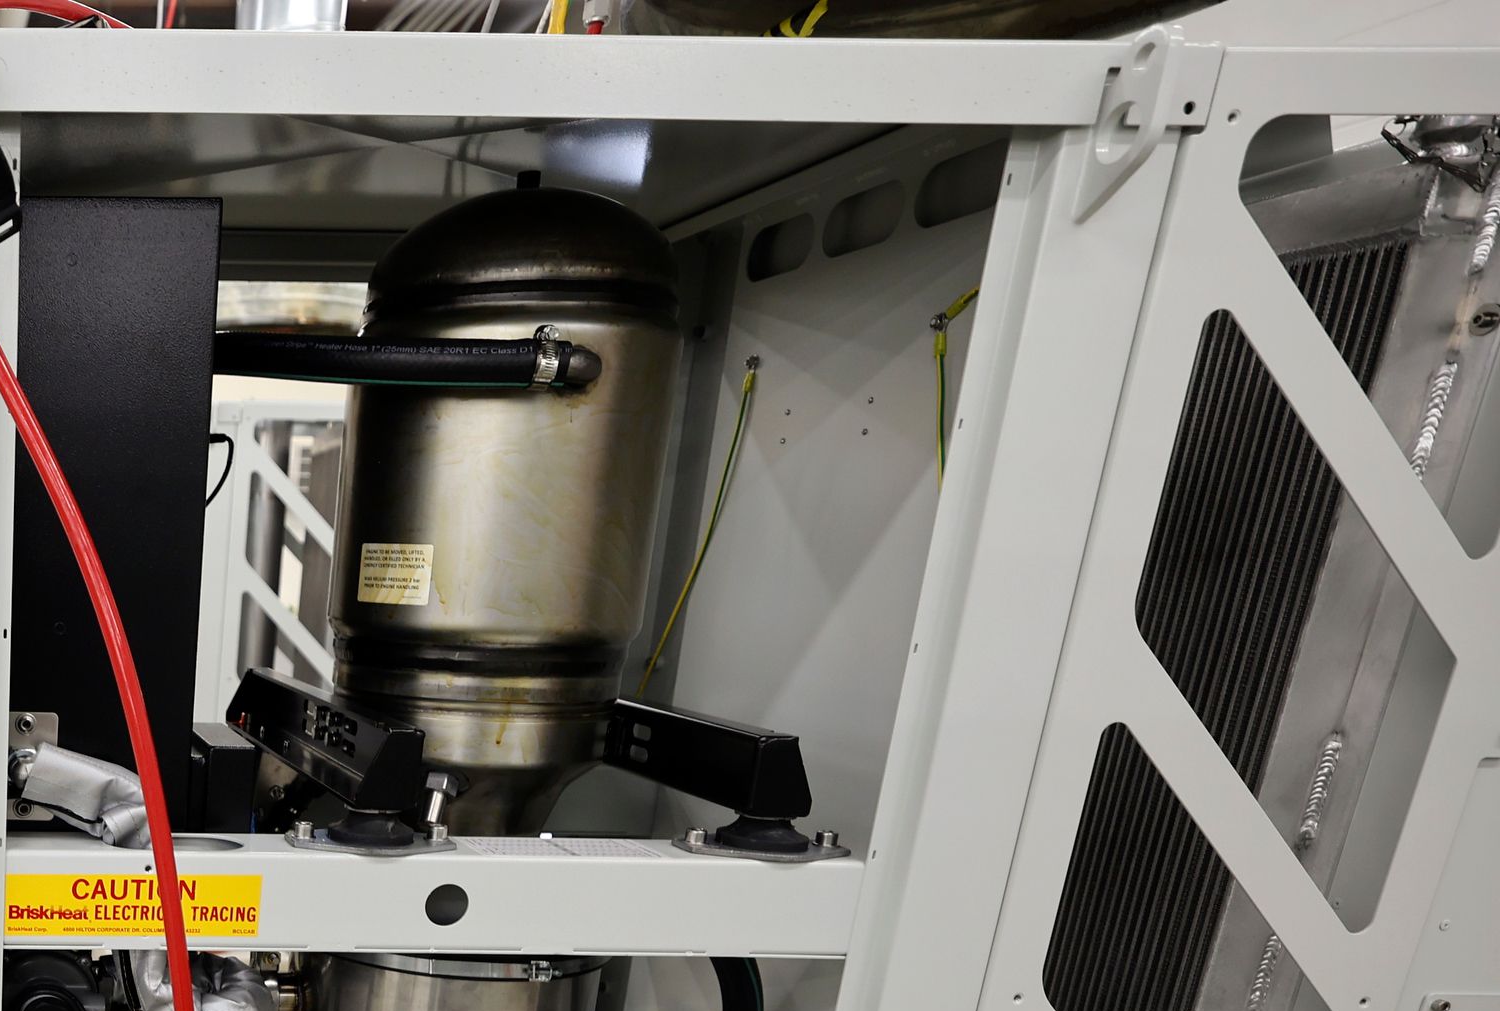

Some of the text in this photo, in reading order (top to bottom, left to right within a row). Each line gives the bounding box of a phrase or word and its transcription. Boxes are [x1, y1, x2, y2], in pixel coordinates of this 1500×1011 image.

[315, 342, 343, 351] Heater
[344, 344, 368, 352] Hose
[381, 345, 417, 354] (25mm)
[419, 346, 442, 354] SAE
[72, 878, 197, 901] CAUTIN
[8, 904, 257, 922] BriskHeat ELECTRIC TRACING
